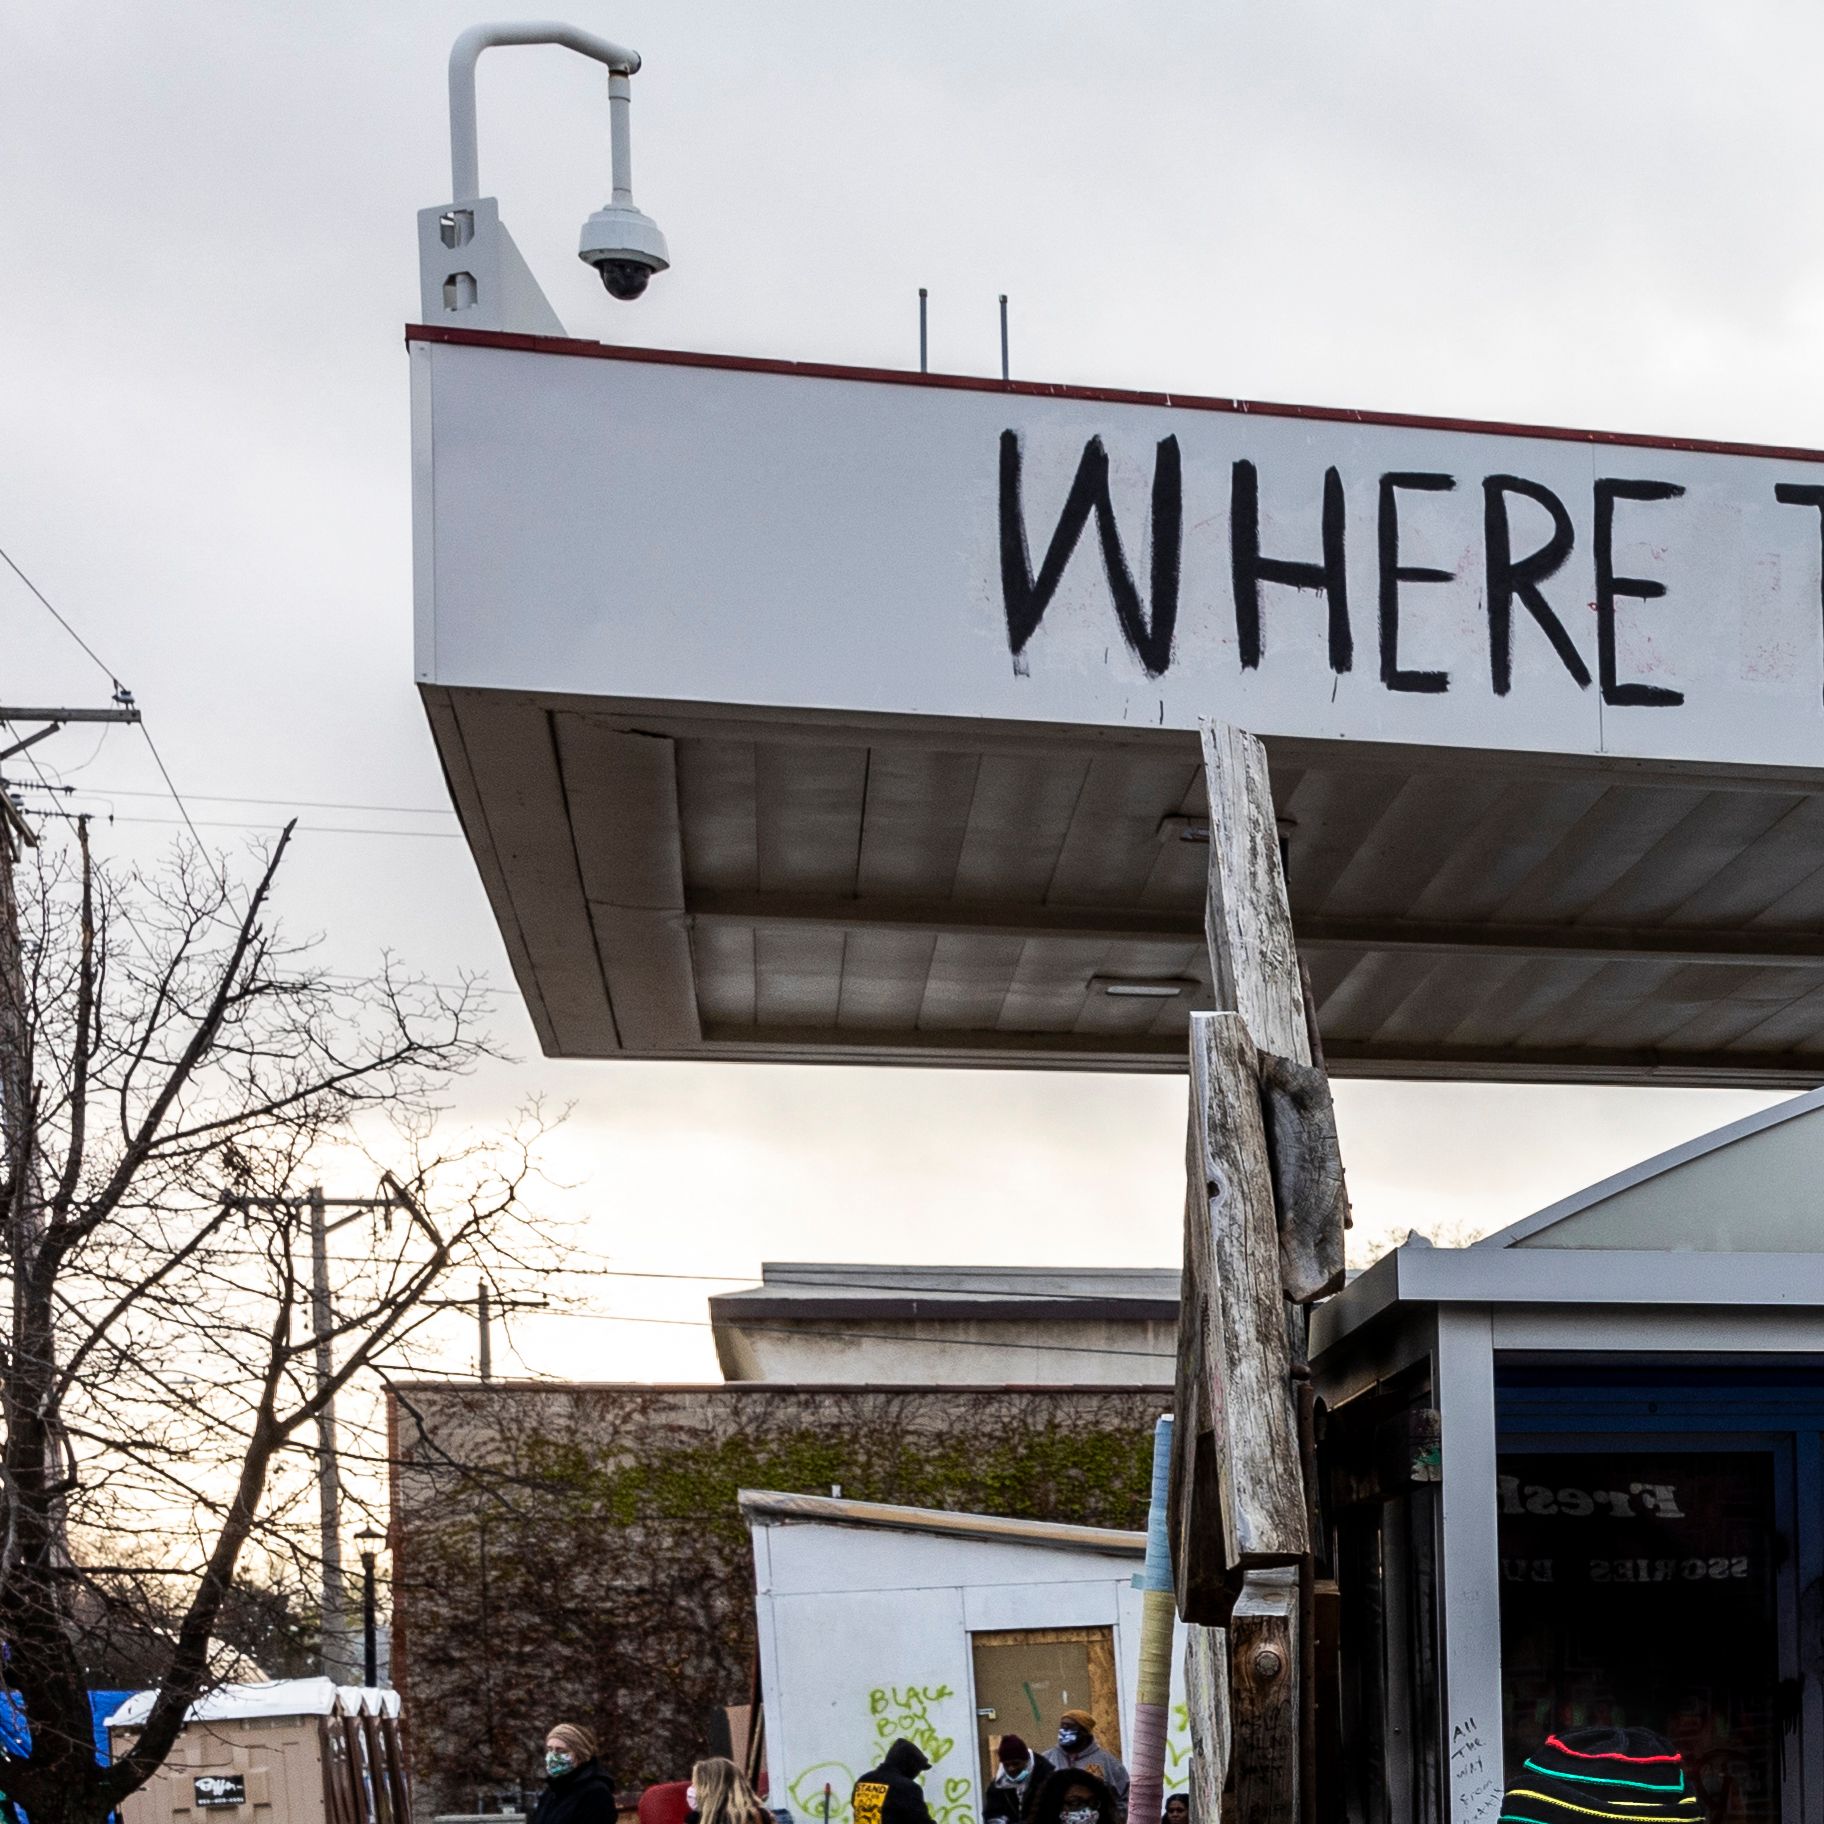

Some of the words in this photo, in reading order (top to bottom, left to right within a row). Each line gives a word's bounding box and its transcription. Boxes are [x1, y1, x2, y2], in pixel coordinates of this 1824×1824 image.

[998, 429, 1688, 708] WHERE
[870, 1685, 954, 1716] BLACK
[855, 1783, 886, 1794] STAND
